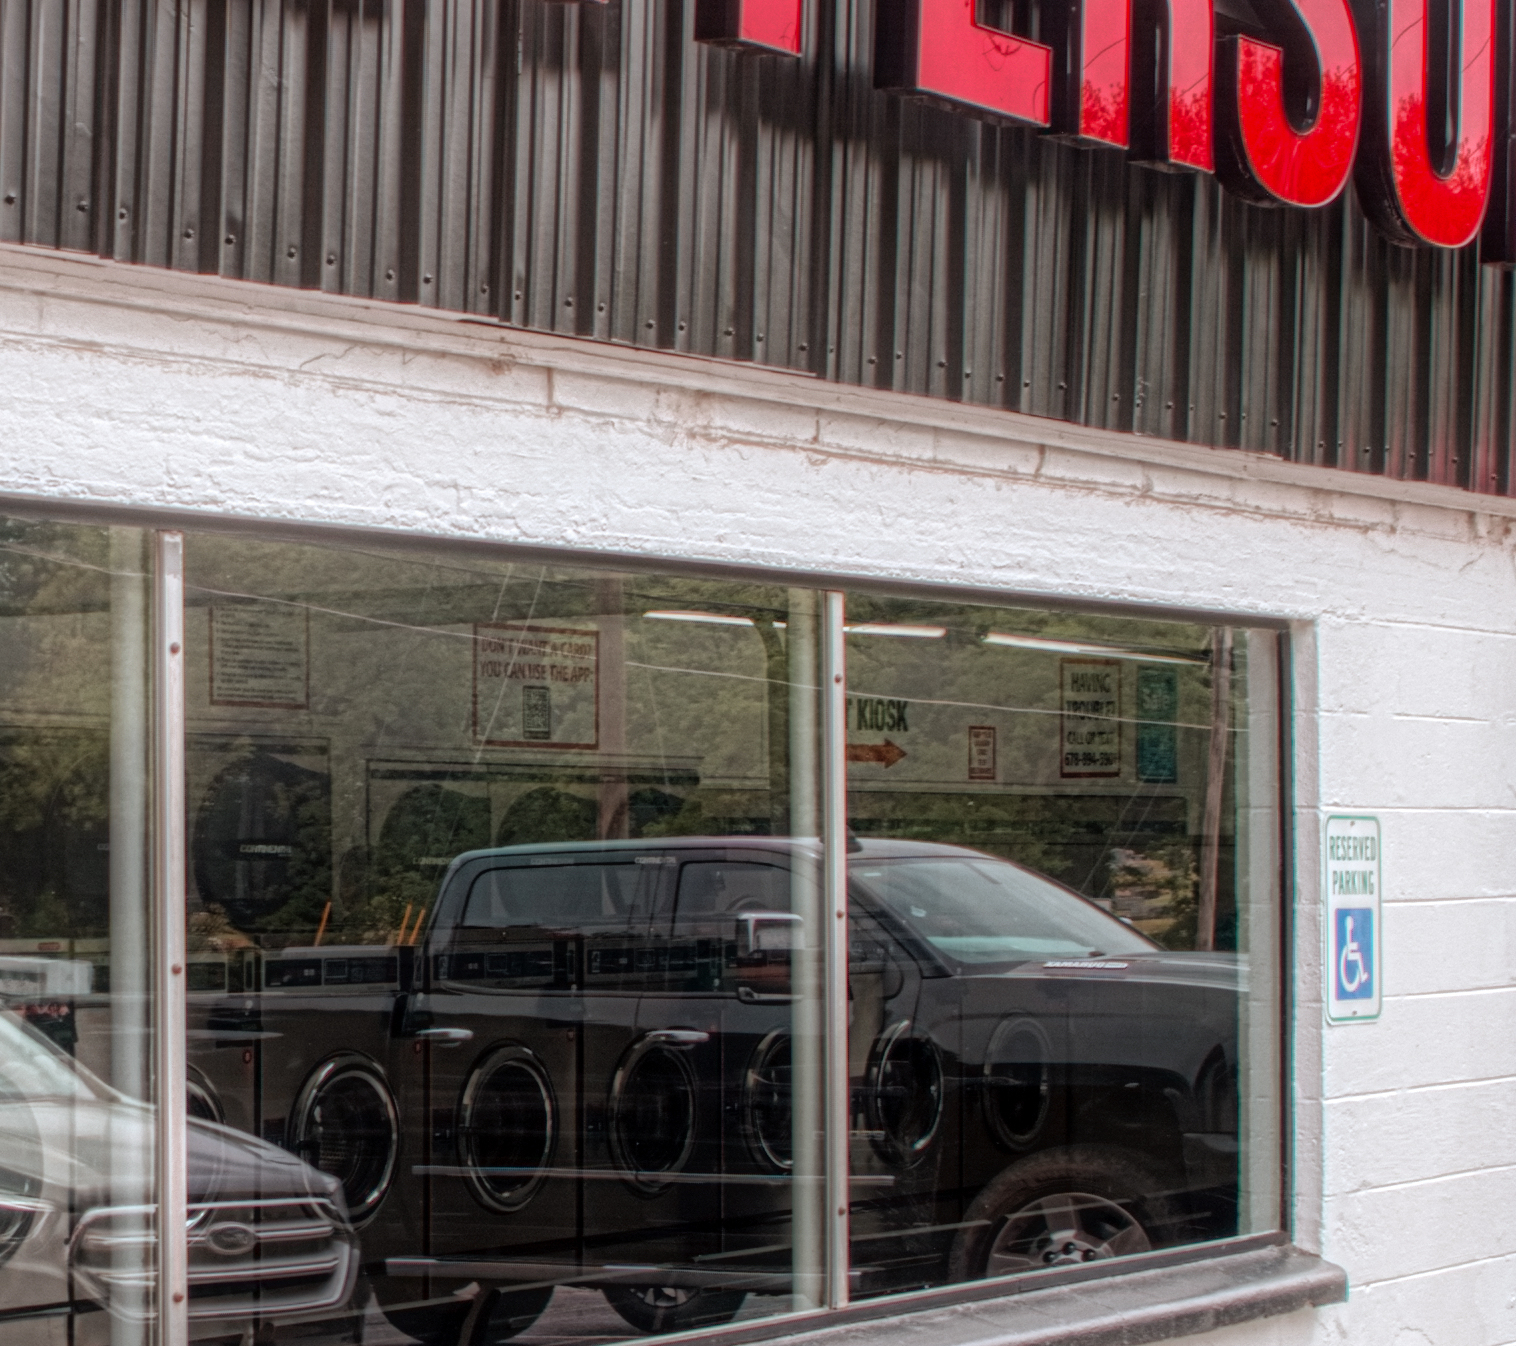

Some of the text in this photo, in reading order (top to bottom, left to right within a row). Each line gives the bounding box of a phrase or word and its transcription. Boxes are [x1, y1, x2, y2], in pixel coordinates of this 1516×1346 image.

[479, 660, 593, 683] YOU CAN USE THE APP:
[1070, 672, 1111, 693] HAVING
[856, 698, 909, 732] KIOSK
[1329, 835, 1376, 861] RESERVED
[1332, 870, 1374, 895] PARKING
